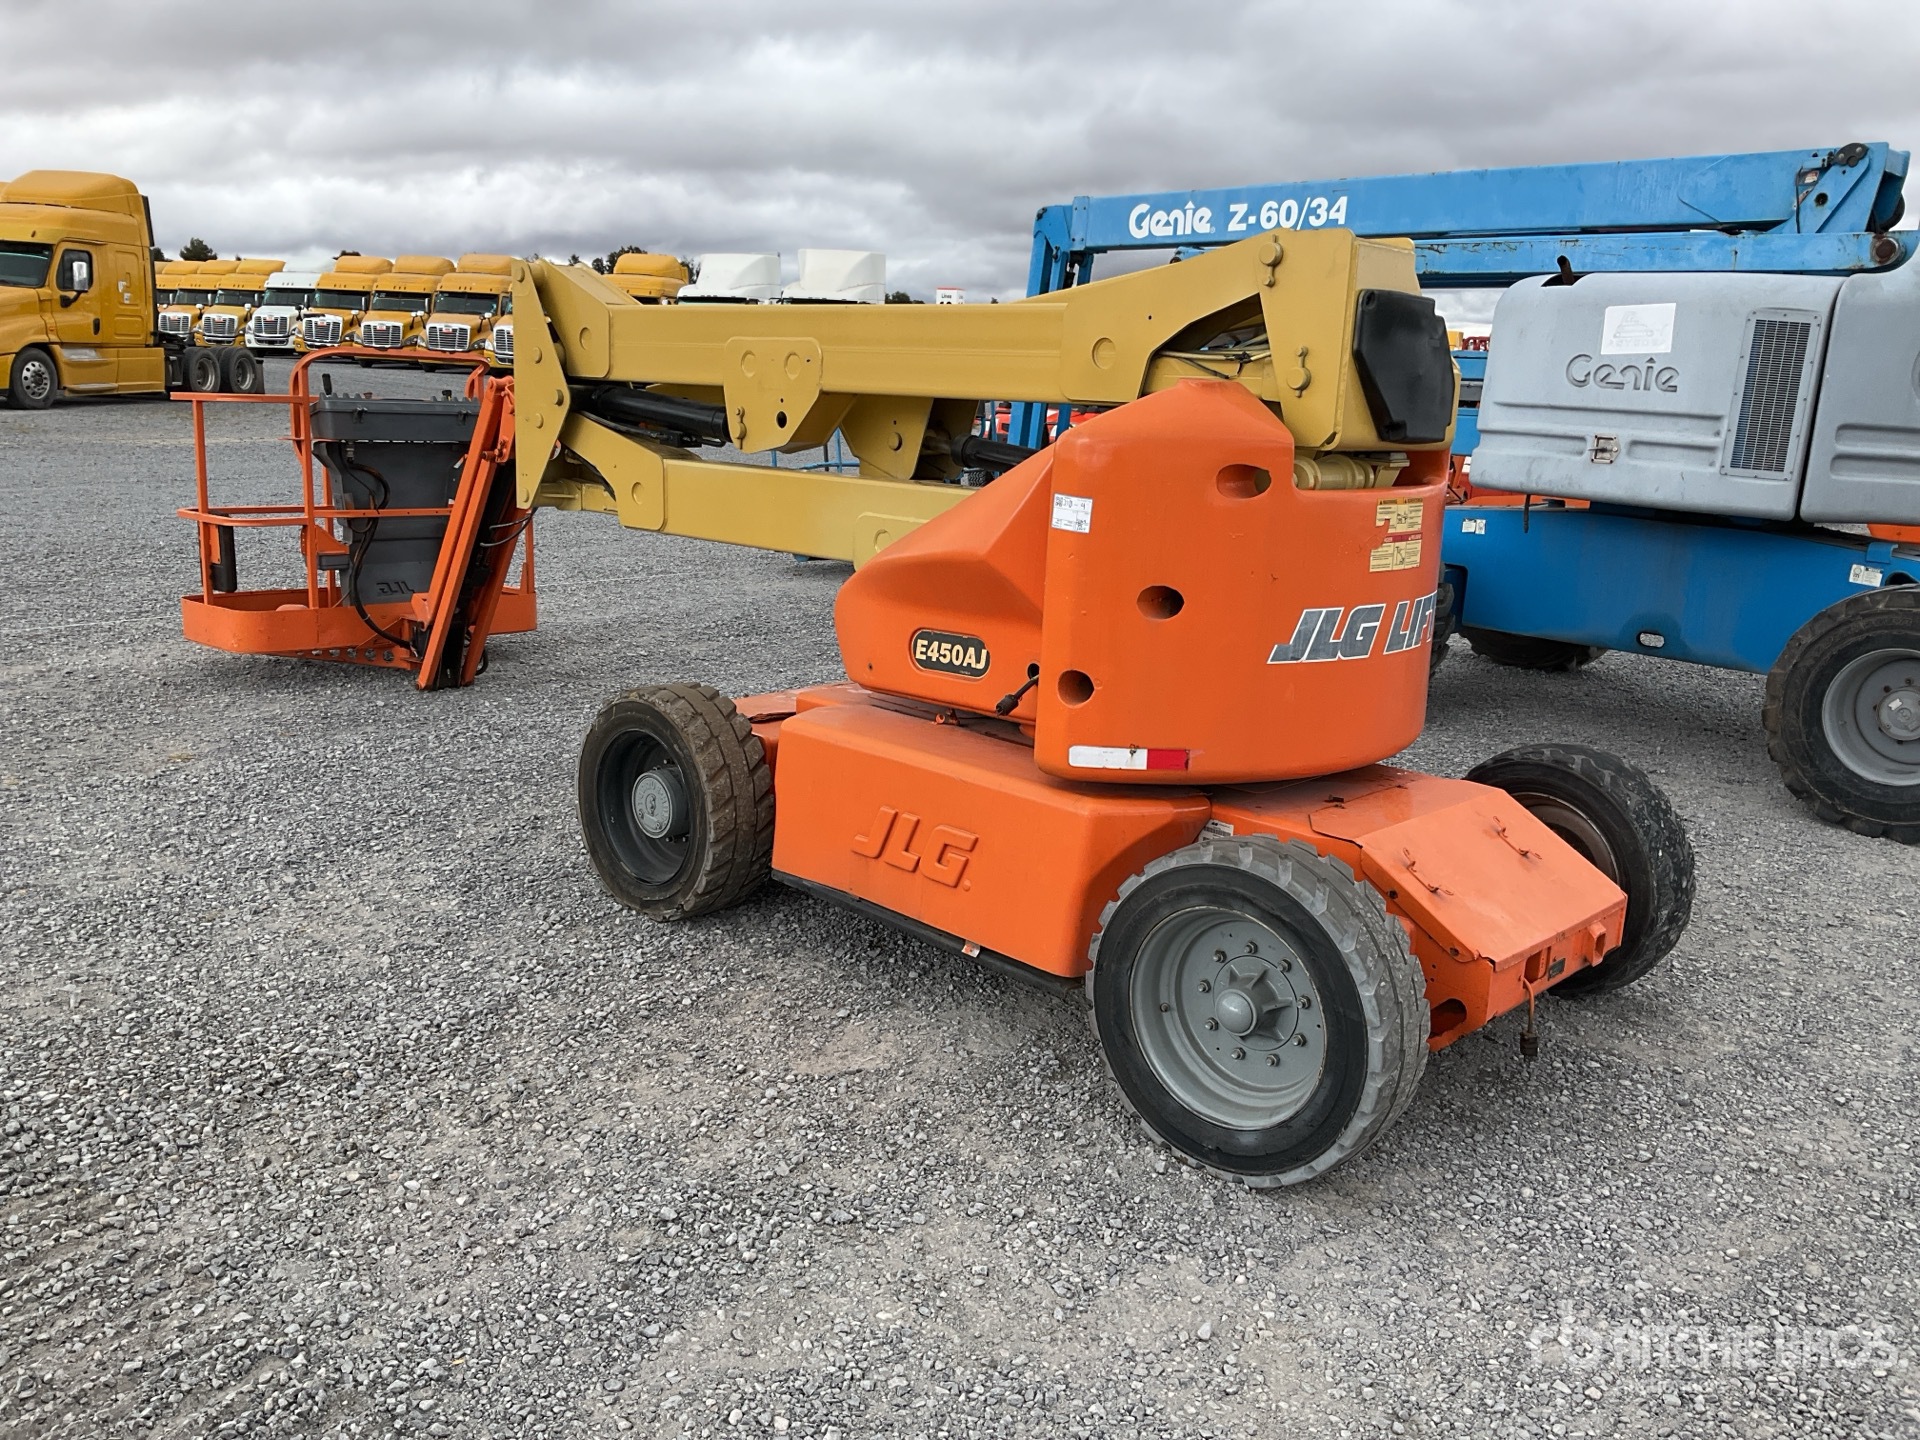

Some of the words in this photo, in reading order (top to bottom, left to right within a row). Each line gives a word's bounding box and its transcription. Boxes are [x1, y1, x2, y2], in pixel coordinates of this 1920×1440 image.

[1128, 200, 1213, 240] Genie
[1227, 196, 1348, 232] Z-60/34
[1565, 353, 1680, 393] Genie
[915, 638, 988, 670] E450AJ
[1266, 602, 1387, 665] JLG
[850, 804, 980, 890] JLG
